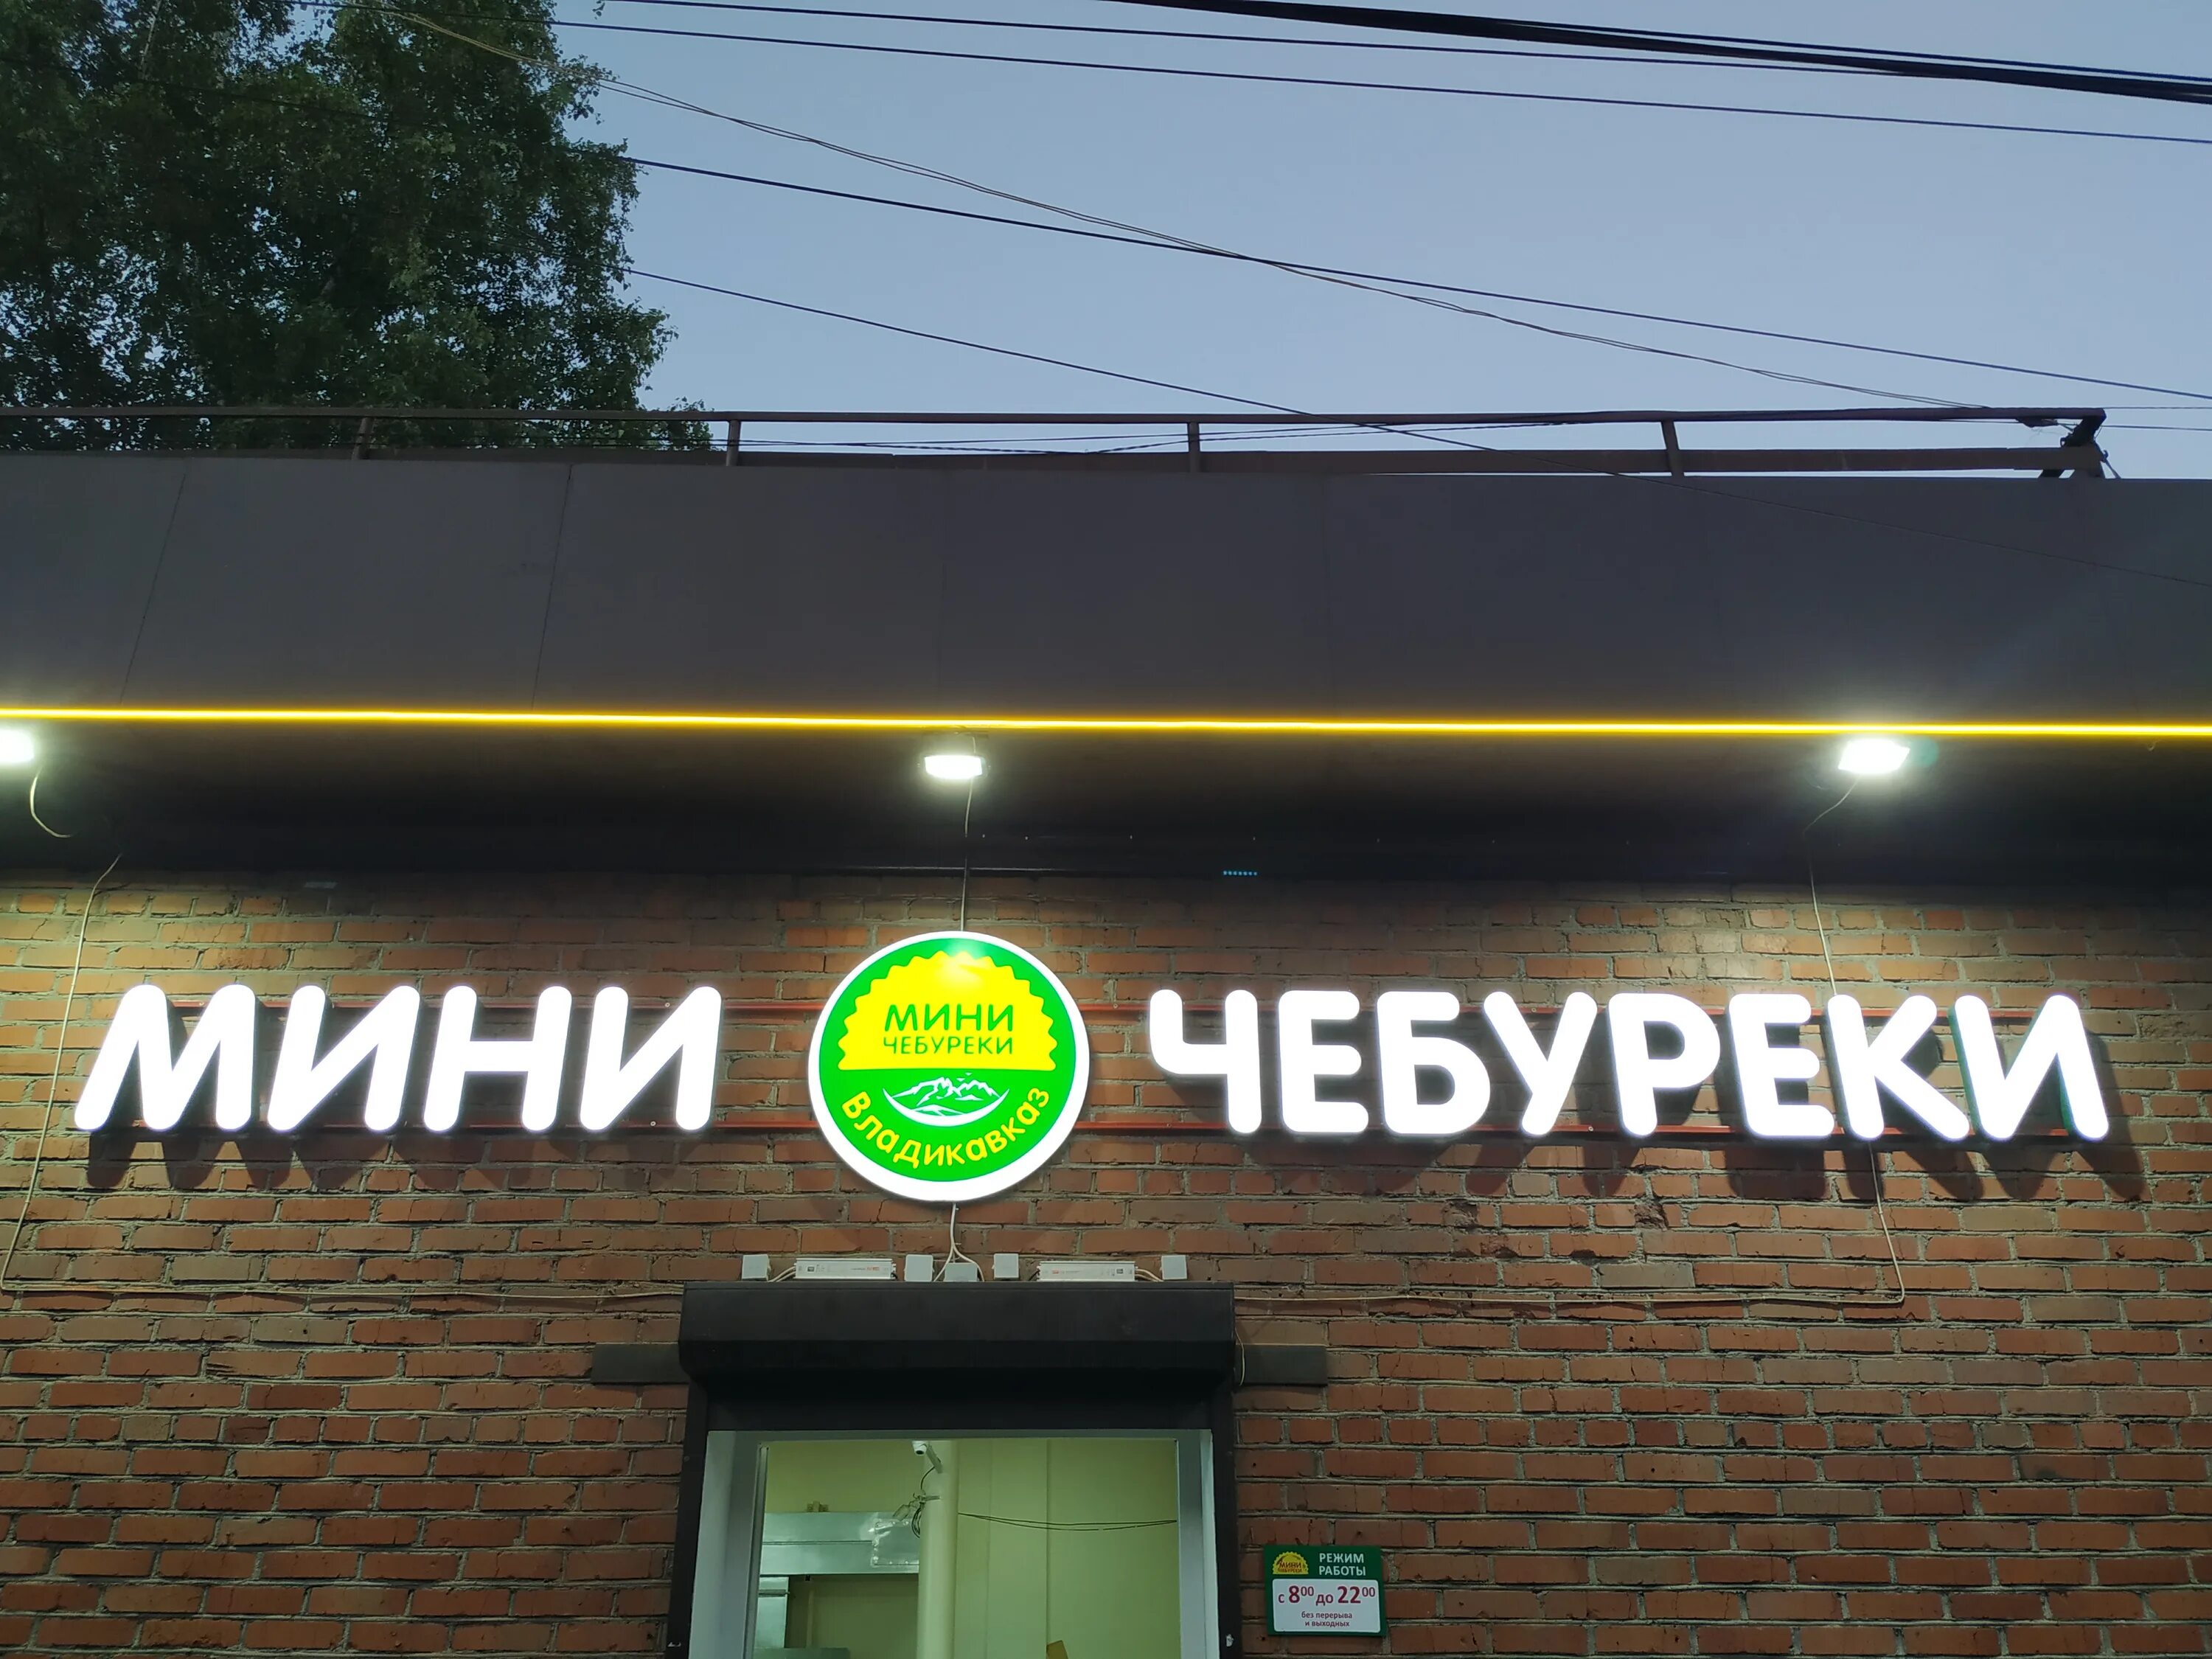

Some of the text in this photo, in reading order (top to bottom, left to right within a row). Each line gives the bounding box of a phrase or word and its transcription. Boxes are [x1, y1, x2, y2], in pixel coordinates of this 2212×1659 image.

[884, 1004, 1014, 1032] МИНИ
[883, 1036, 1013, 1055] ЧЕБУРЕКИ
[74, 984, 722, 1131] МИНИ
[1149, 989, 2110, 1139] ЧЕБУРЕКИ
[841, 1088, 1050, 1169] Владикавказ
[1319, 1552, 1365, 1564] РЕЖИМ
[1318, 1565, 1366, 1576] РАБОТЫ
[1315, 1594, 1334, 1606] до
[1301, 1610, 1314, 1618] без
